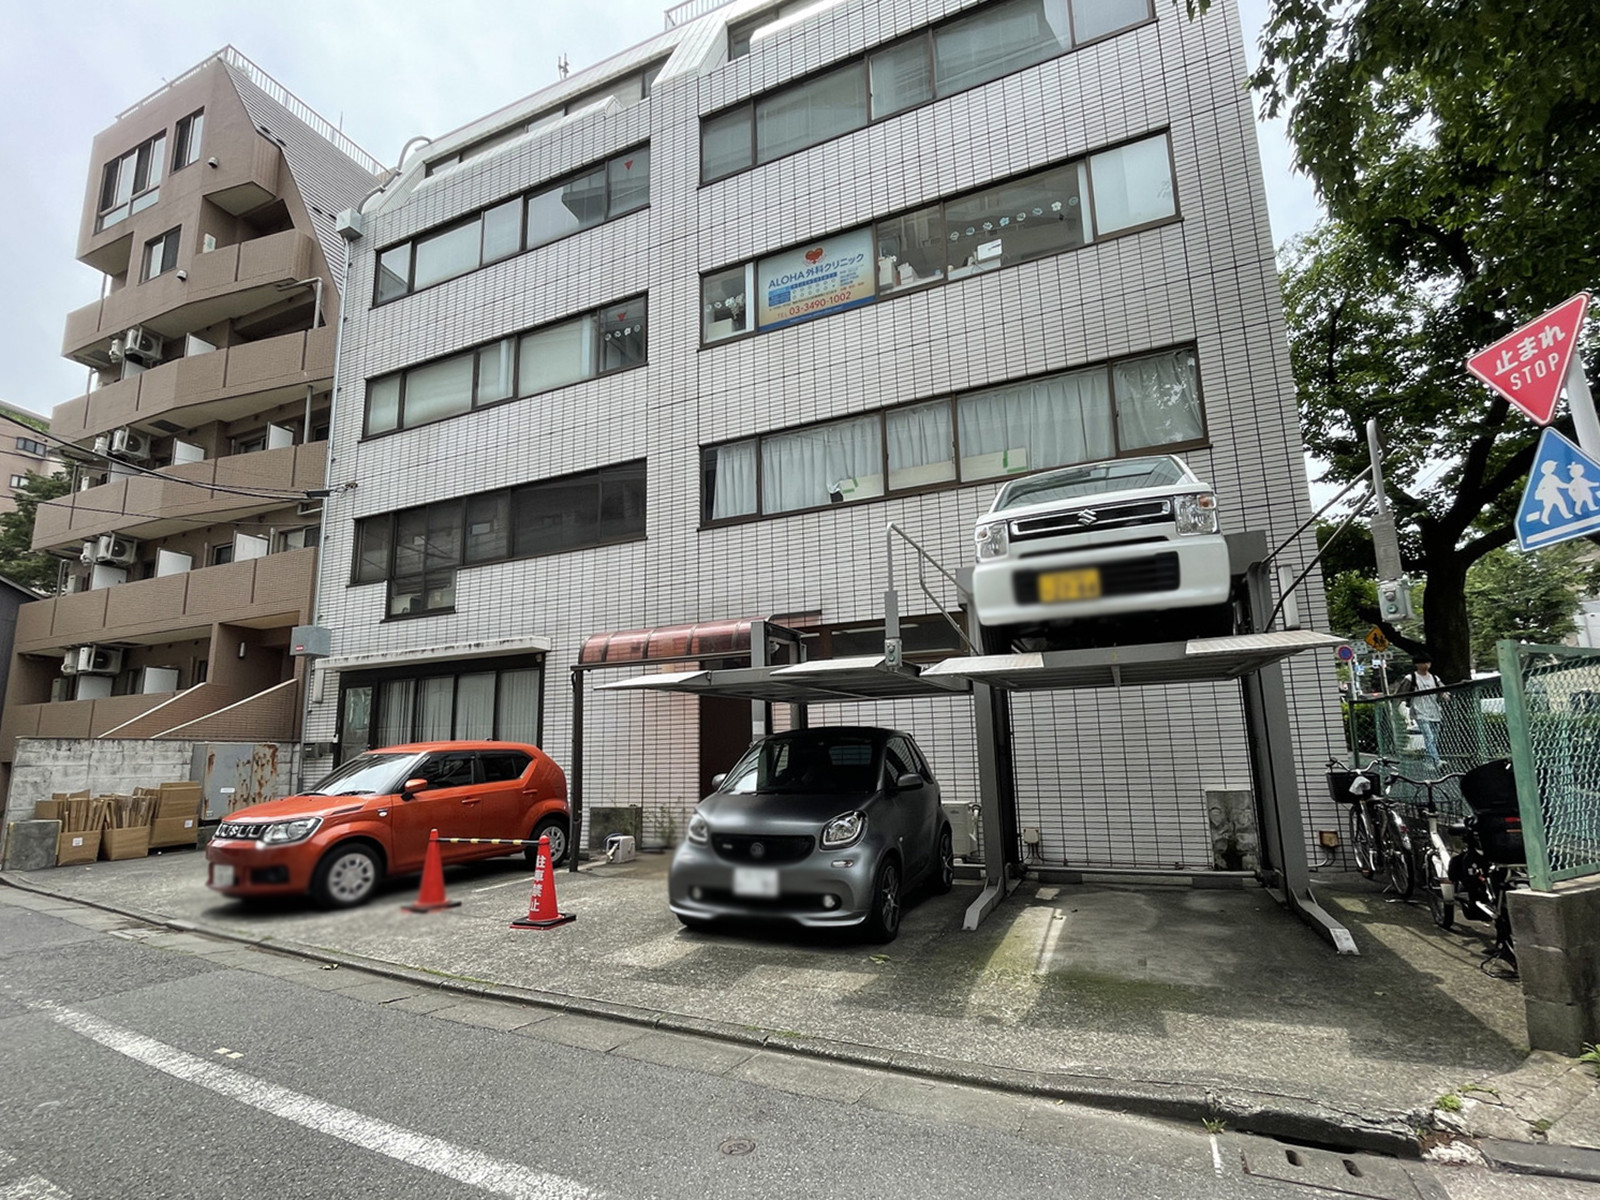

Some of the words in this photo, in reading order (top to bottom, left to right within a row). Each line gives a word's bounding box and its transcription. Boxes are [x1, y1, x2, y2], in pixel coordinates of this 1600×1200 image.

[768, 253, 864, 289] ALOHA外科クリニック
[789, 291, 852, 316] 03-3490-1002
[1495, 325, 1566, 376] 止まれ
[1510, 352, 1559, 391] STOP
[530, 854, 547, 912] 駐車禁止
